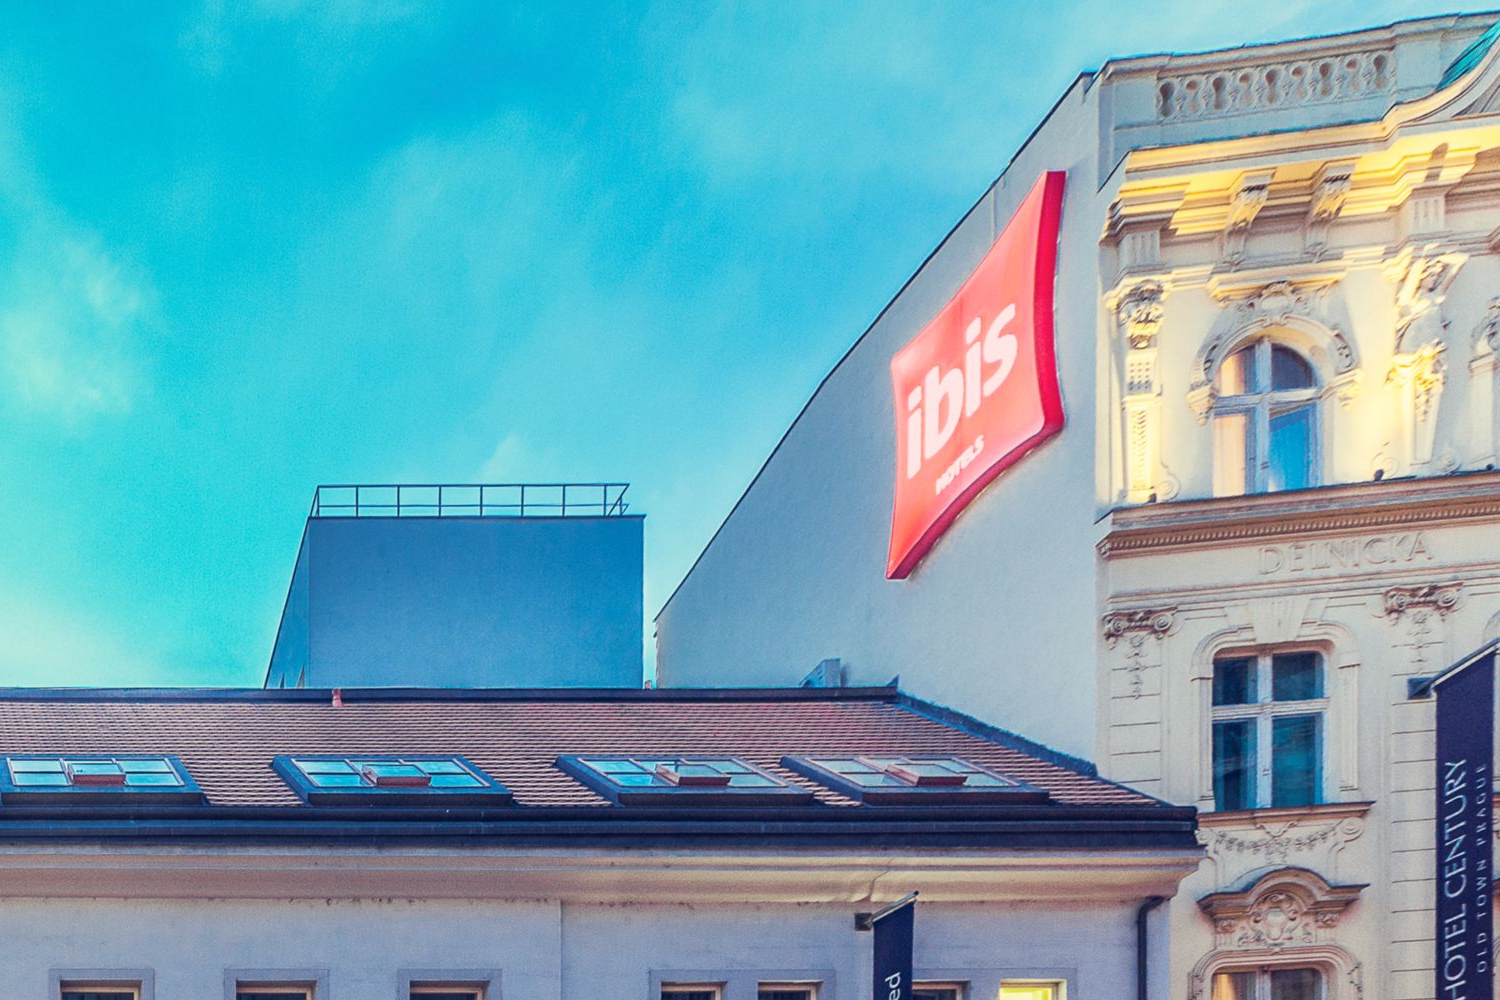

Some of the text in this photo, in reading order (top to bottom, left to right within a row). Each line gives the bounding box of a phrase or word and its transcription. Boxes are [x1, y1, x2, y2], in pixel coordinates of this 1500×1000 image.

[907, 303, 1018, 480] ibis
[935, 434, 985, 495] HOTELS
[1444, 758, 1467, 898] CENTURY
[1475, 765, 1488, 974] OLD TOWN PRAGUE
